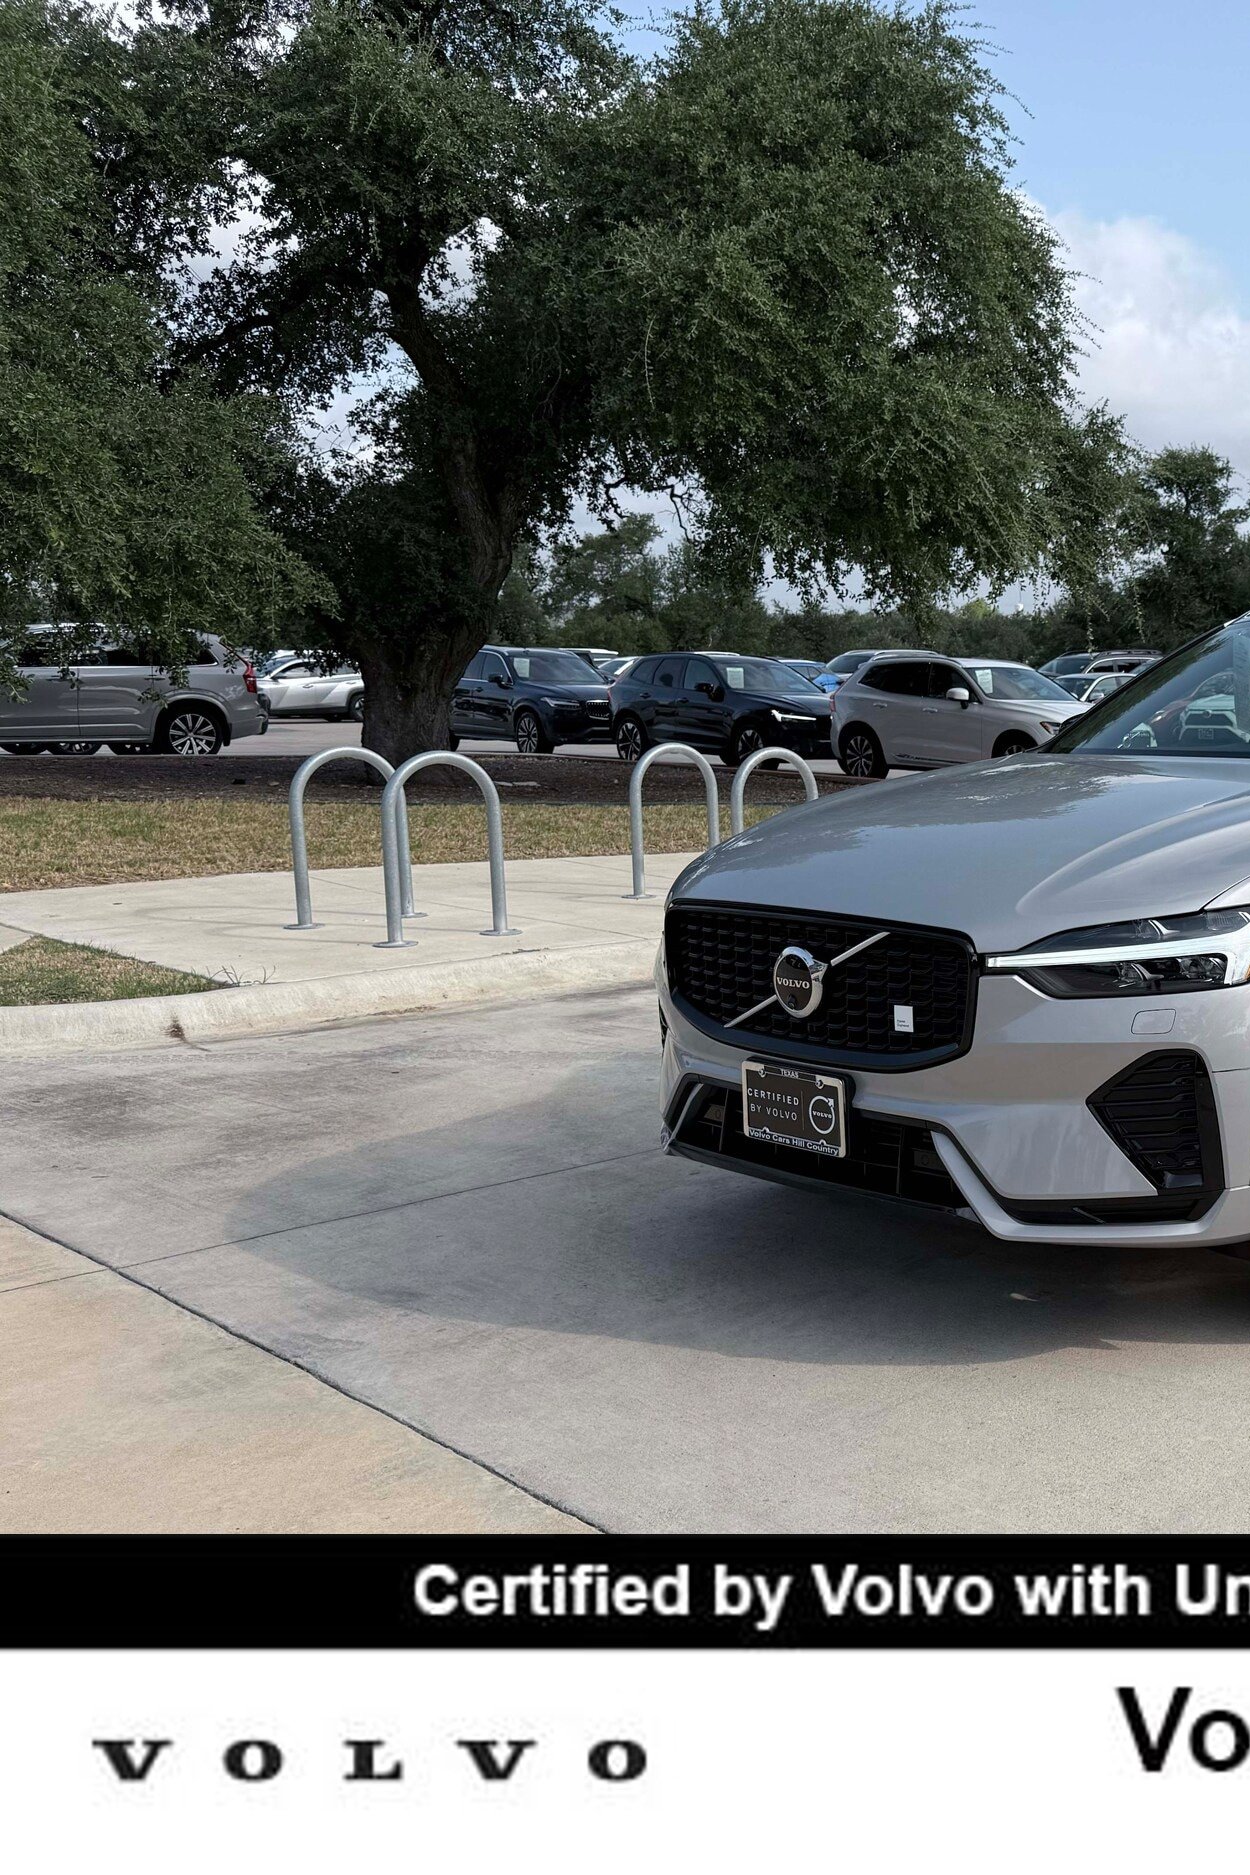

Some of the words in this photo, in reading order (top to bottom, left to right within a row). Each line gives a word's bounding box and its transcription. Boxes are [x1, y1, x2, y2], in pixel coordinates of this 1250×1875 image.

[776, 977, 810, 989] VOLVO
[780, 1069, 799, 1079] TEXAS
[747, 1088, 799, 1105] CERTIFIED
[750, 1103, 762, 1113] BY
[766, 1107, 797, 1120] VOLVO
[812, 1110, 832, 1118] VOLVO
[749, 1129, 771, 1140] Volvo
[772, 1135, 790, 1144] Cars
[806, 1143, 839, 1155] Country
